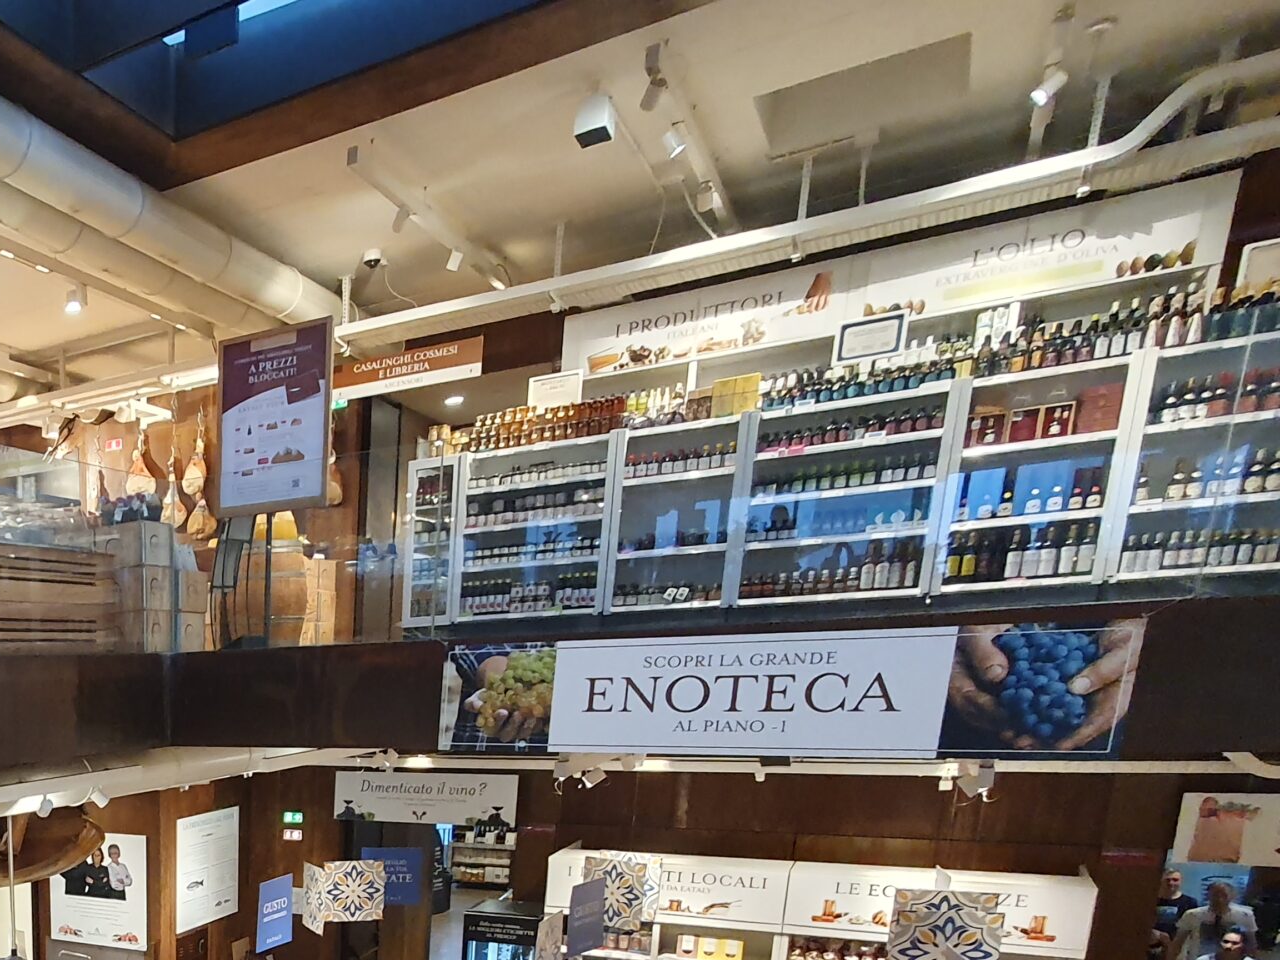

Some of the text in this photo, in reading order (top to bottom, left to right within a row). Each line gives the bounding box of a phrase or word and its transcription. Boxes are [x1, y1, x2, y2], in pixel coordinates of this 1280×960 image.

[971, 228, 1086, 268] L'OLIO
[1056, 244, 1120, 267] D'OLIVA
[628, 289, 785, 337] PRODUTTORI
[413, 345, 458, 362] COSMESI
[248, 355, 297, 375] A PREZZI
[378, 361, 430, 379] E LIBRERIA
[248, 367, 298, 384] BLOCCATI!
[643, 651, 838, 669] SCOPRI LA GRANDE
[581, 671, 902, 714] ENOTECA
[672, 719, 787, 733] AL PIANO -1
[360, 779, 433, 796] Dimenticato
[436, 781, 446, 796] il
[384, 873, 414, 883] TATE
[691, 872, 768, 890] LOCALI
[680, 885, 711, 895] EATALY
[835, 881, 861, 895] LE
[263, 897, 288, 914] GUSTO
